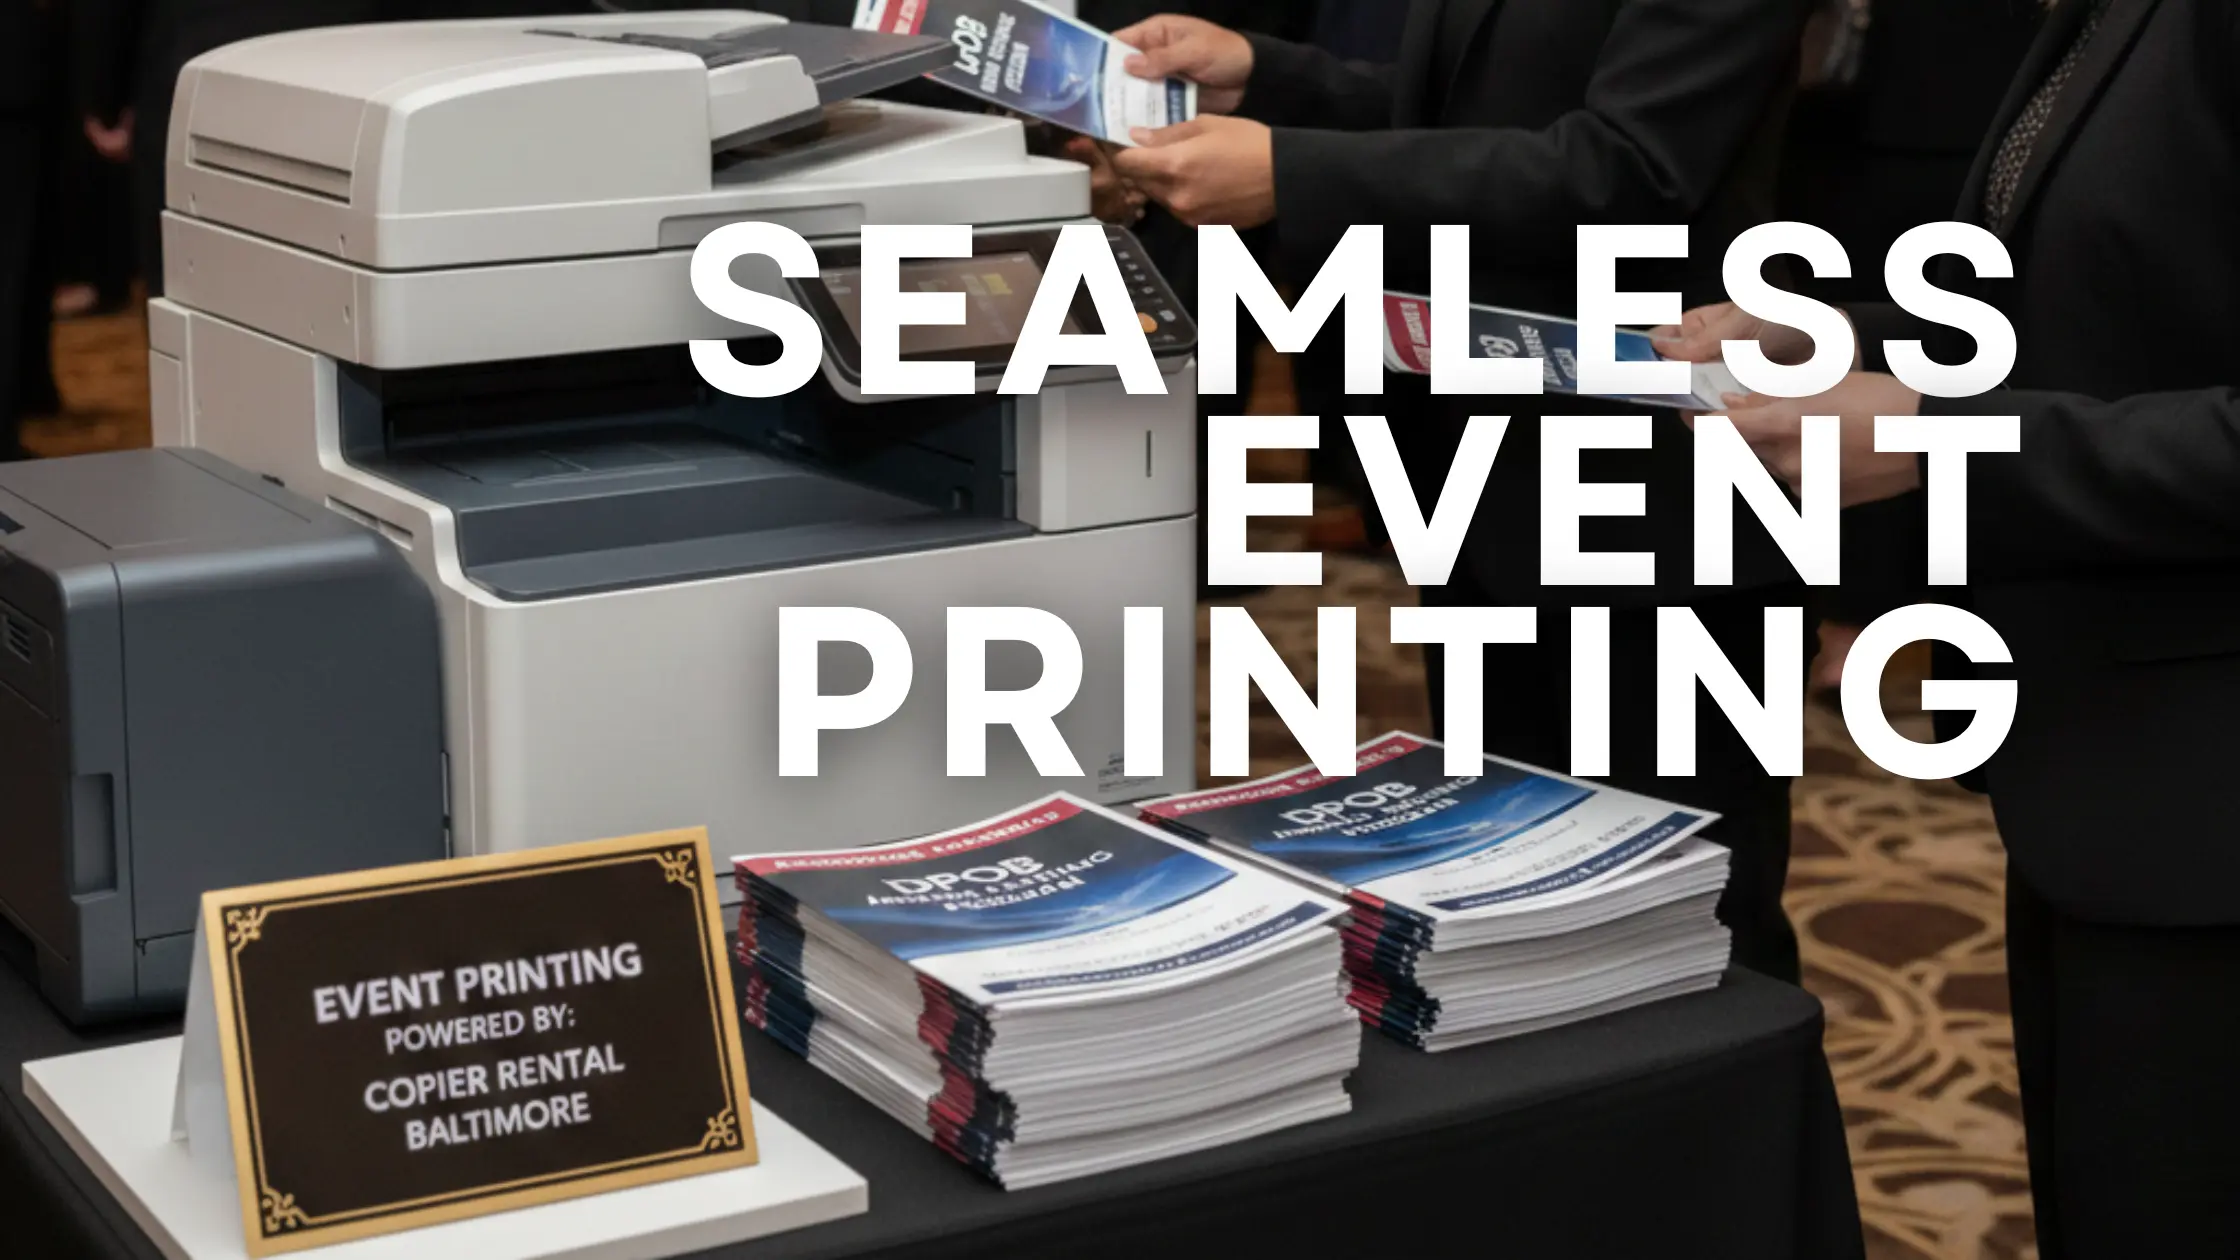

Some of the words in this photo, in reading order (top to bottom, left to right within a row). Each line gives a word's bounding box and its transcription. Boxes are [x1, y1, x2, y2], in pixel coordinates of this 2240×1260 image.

[313, 970, 444, 1024] EVENT
[455, 942, 643, 1002] PRINTING
[385, 1010, 524, 1054] POWERED
[532, 1003, 576, 1033] BY:
[364, 1065, 488, 1112] COPIER
[497, 1043, 625, 1091] RENTAL
[405, 1092, 591, 1151] BALTIMORE
